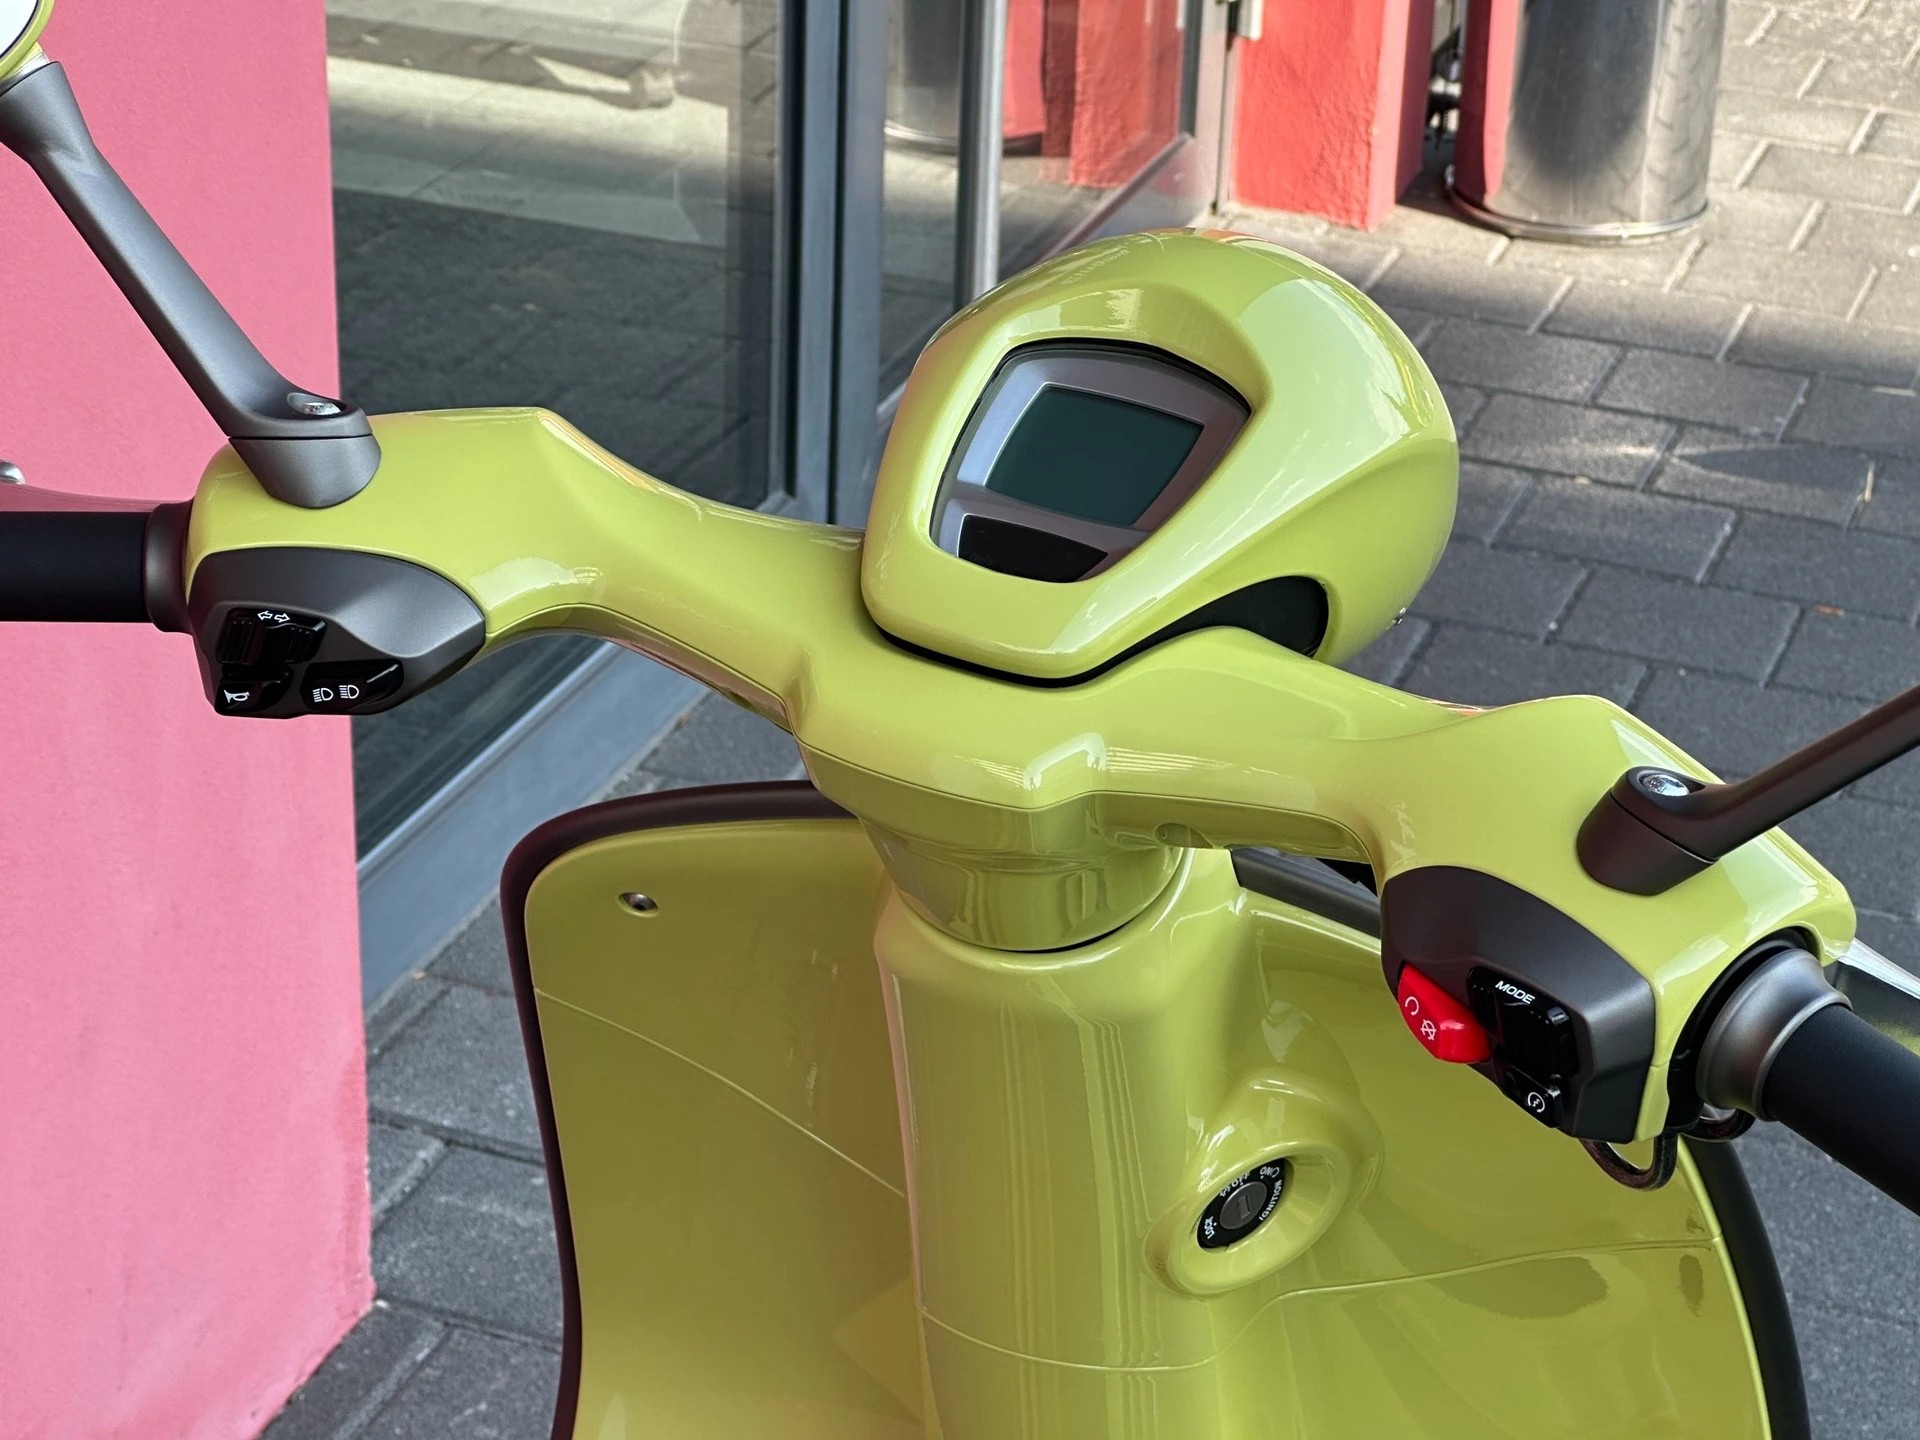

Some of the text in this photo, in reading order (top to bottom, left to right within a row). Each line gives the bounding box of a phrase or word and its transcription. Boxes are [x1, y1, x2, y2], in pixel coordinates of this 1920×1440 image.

[1495, 980, 1535, 1004] MODE
[1259, 1180, 1282, 1221] IGNITION
[1204, 1216, 1214, 1239] LOCK
